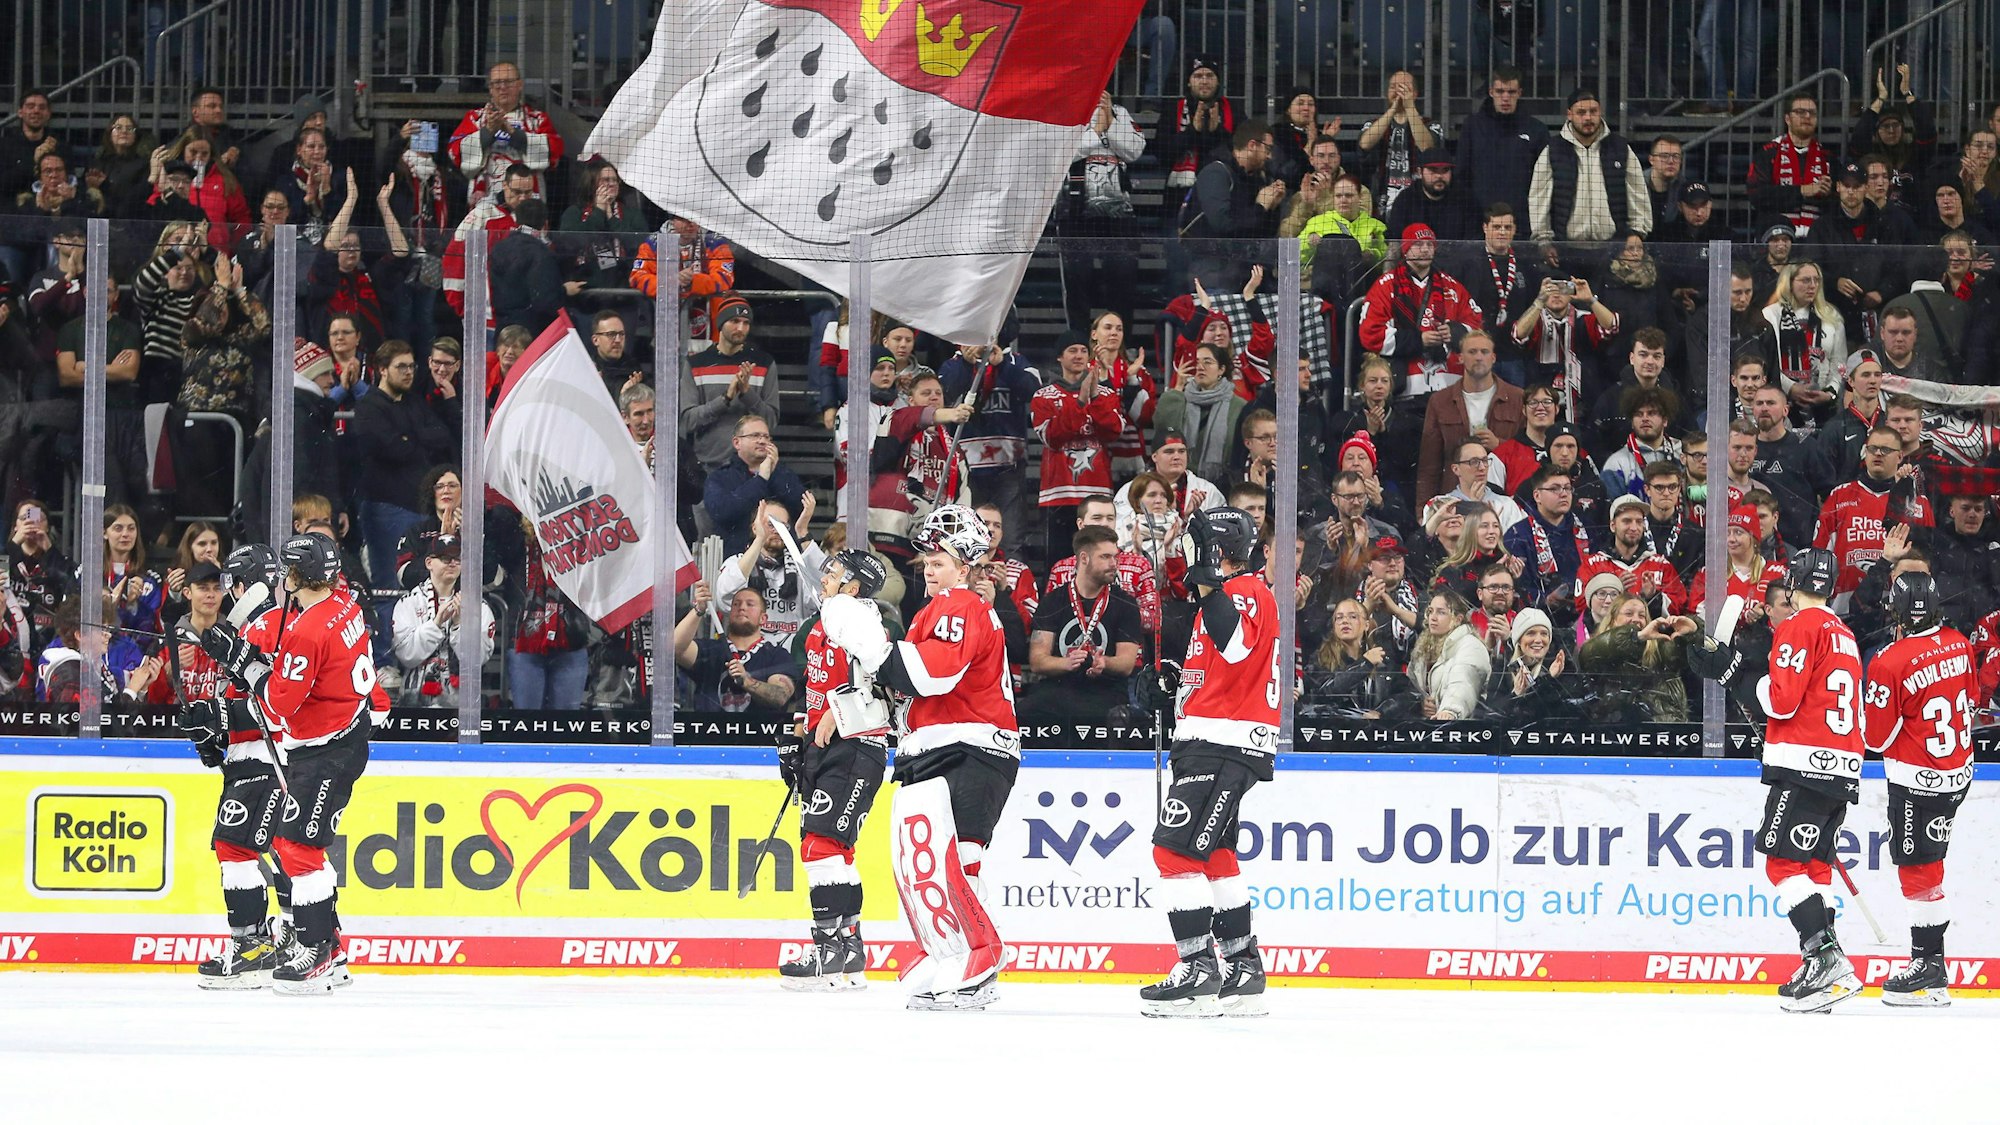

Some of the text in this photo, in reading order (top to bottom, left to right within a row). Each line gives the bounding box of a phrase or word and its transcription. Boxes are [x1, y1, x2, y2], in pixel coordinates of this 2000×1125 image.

[1852, 517, 1884, 530] Rhe
[326, 550, 335, 559] 92
[1818, 562, 1828, 571] 34
[1914, 600, 1924, 609] 33
[933, 615, 965, 643] 45
[281, 652, 310, 682] 92
[826, 649, 835, 667] C
[1775, 643, 1808, 674] 34
[1864, 679, 1891, 710] 33
[673, 722, 795, 735] STAHLWE
[1922, 687, 1974, 759] 33
[1175, 773, 1216, 787] BAUER
[1806, 772, 1835, 781] BAUER
[260, 788, 282, 828] TOYOTA
[311, 778, 332, 821] TOYOTA
[844, 778, 865, 816] TOYOTA
[1203, 790, 1231, 832] TOYOTA
[1771, 789, 1792, 831] TOYOTA
[54, 810, 148, 840] Radio
[1237, 821, 1333, 863] om
[1357, 807, 1490, 865] Job
[1513, 824, 1623, 867] zur
[63, 845, 136, 873] Köln
[569, 804, 794, 893] Köln
[1002, 877, 1153, 909] netværk
[1247, 879, 1844, 926] sonalberatung auf Augenhe
